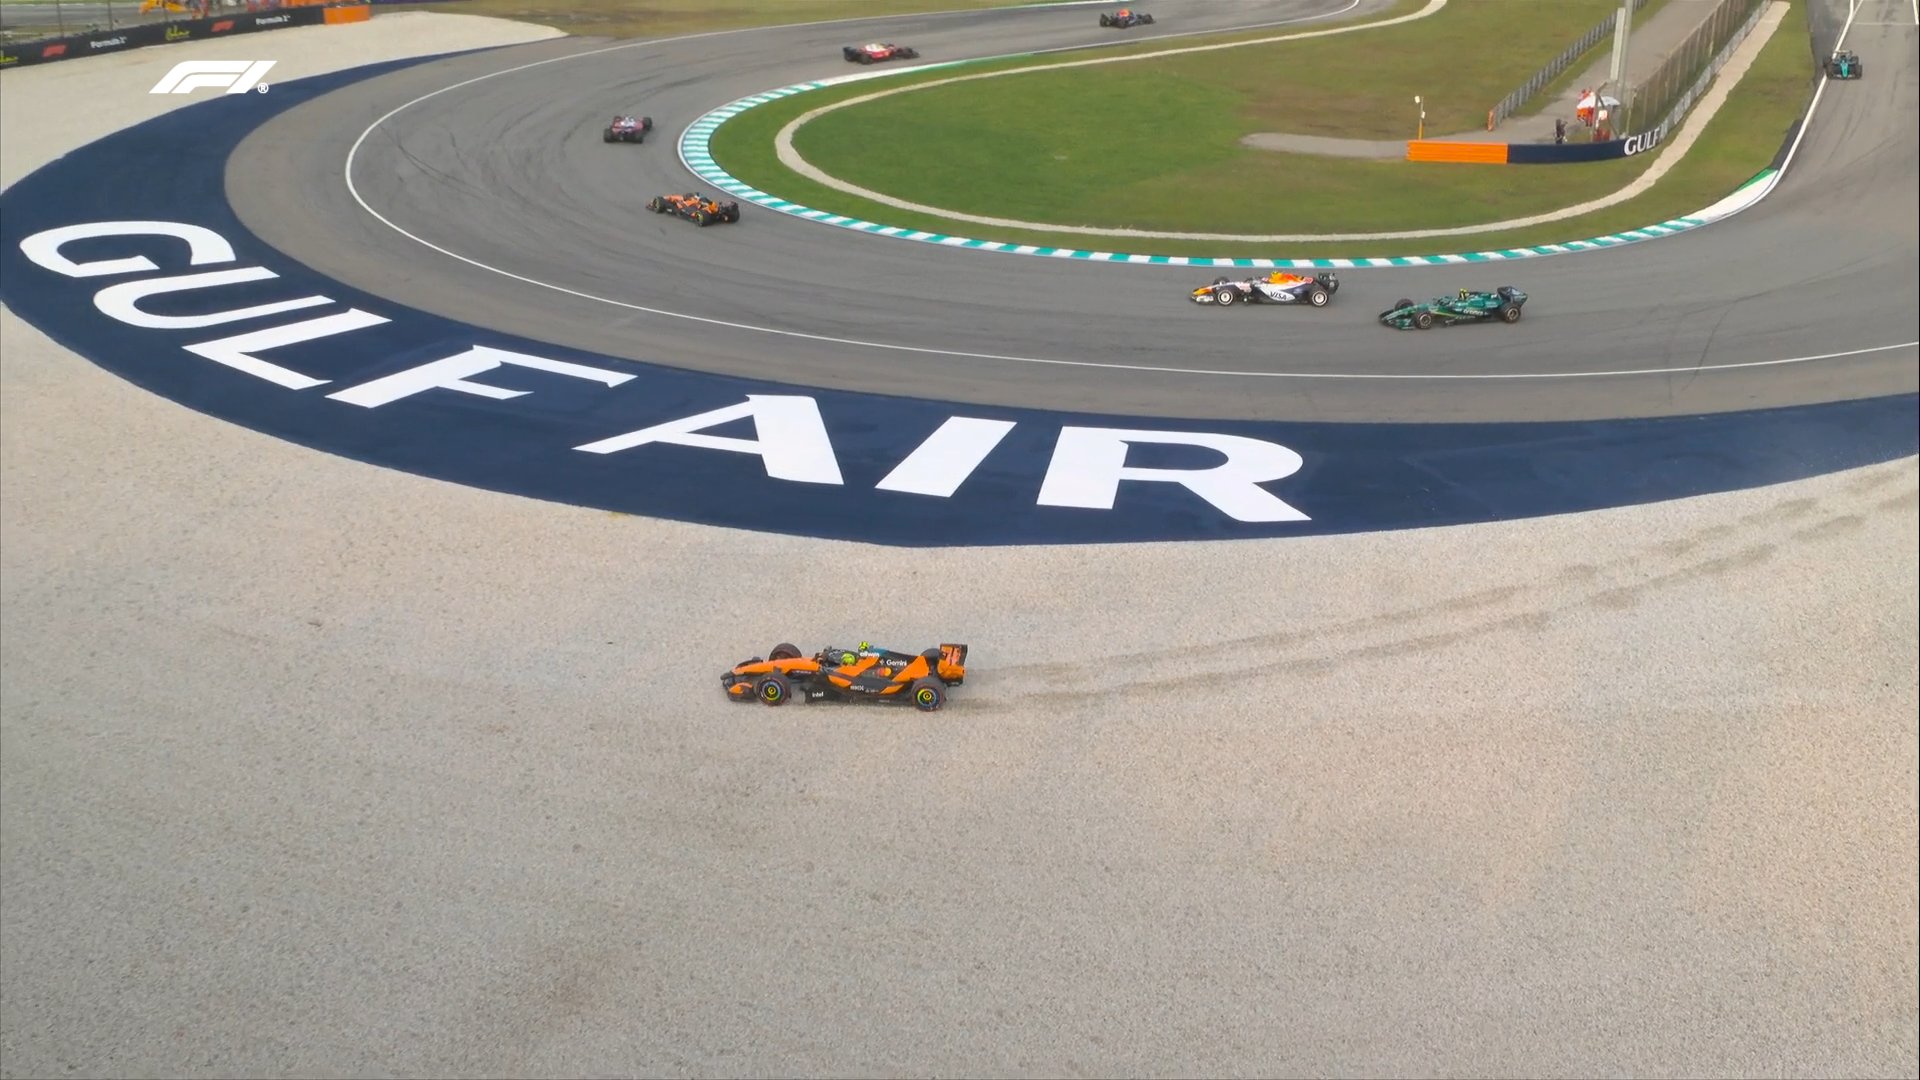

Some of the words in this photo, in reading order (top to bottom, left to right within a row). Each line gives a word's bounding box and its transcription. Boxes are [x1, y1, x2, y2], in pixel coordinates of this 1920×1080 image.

[1624, 127, 1660, 156] GULF
[1269, 291, 1288, 301] VISA
[20, 220, 637, 410] GULF
[574, 394, 1312, 523] AIR
[886, 659, 907, 667] Gemini
